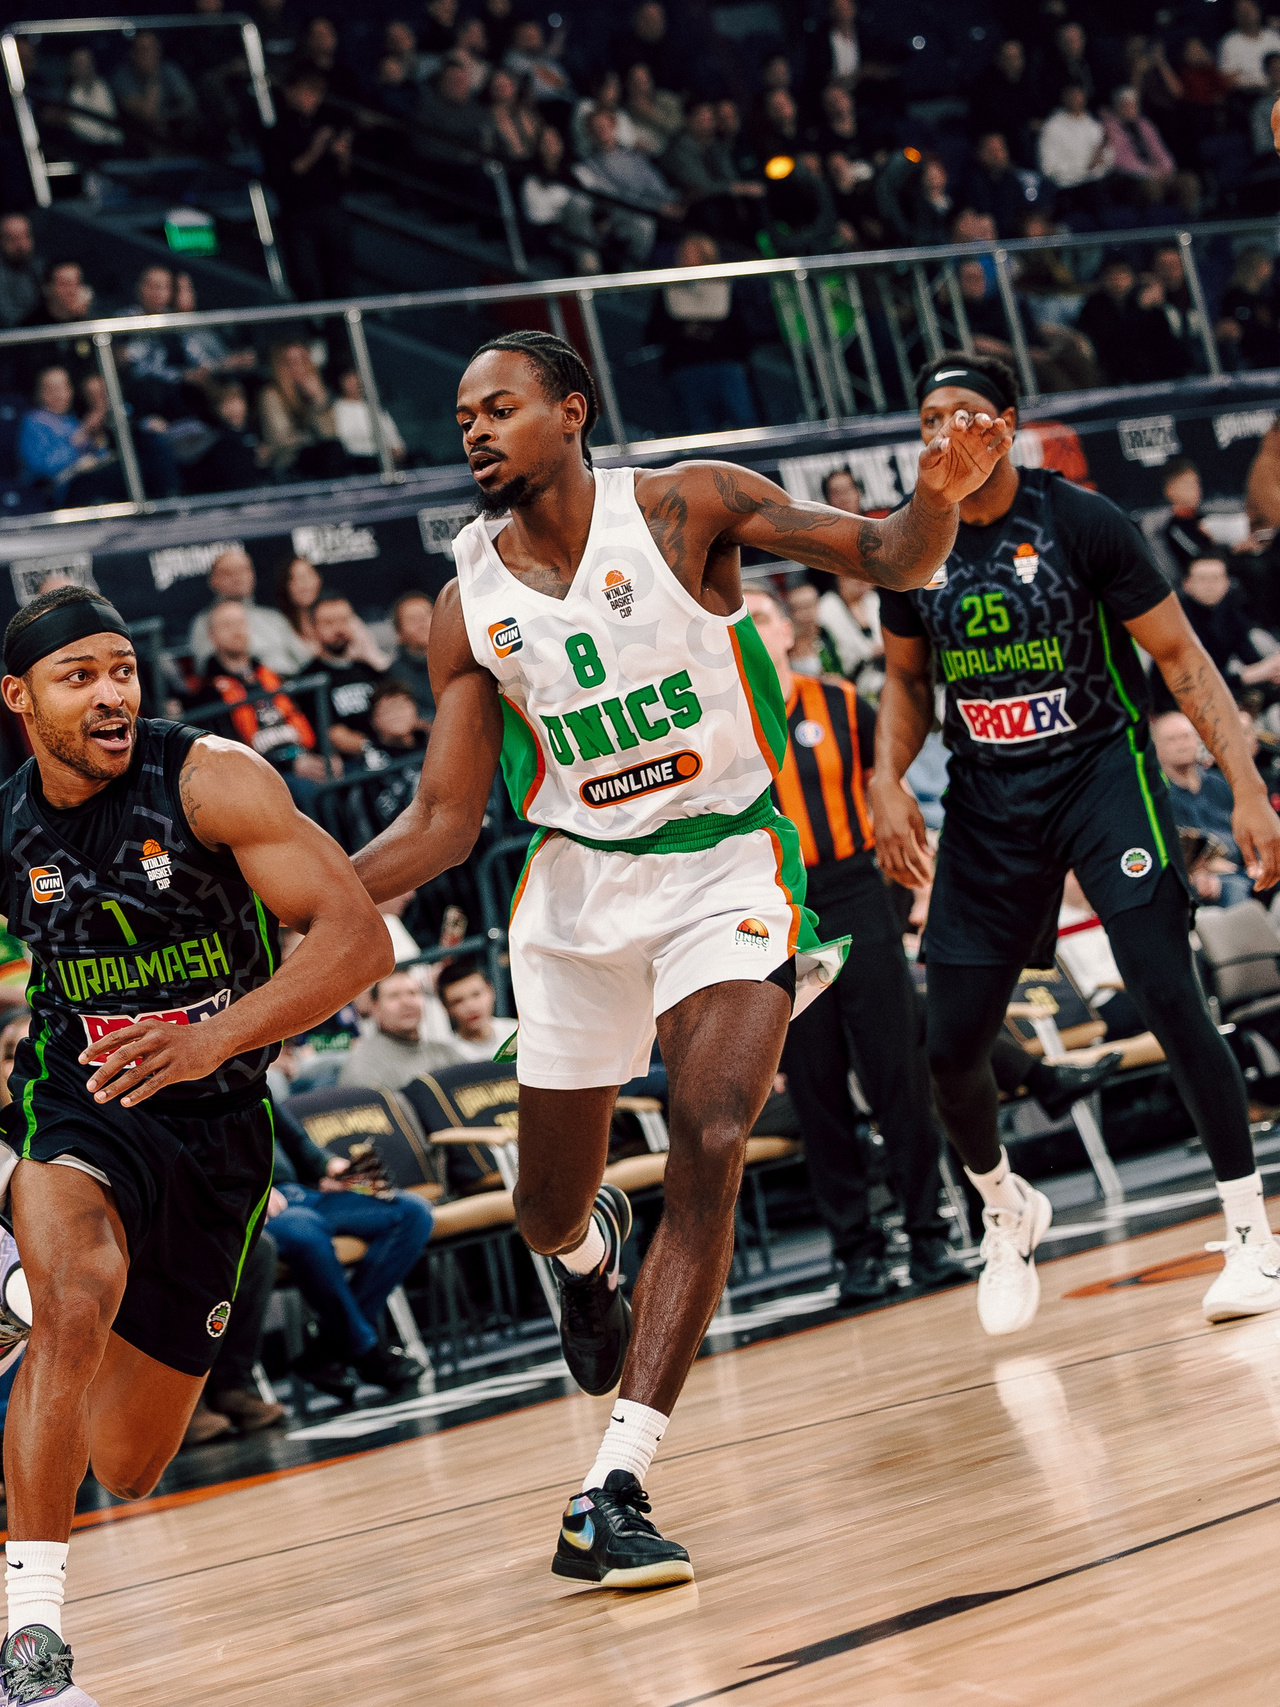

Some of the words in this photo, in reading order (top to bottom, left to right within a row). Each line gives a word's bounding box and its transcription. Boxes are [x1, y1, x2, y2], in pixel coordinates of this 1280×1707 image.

[604, 582, 634, 601] WINLINE
[610, 593, 635, 611] BASKET
[620, 607, 633, 619] CUP
[961, 592, 1012, 638] 25
[497, 626, 519, 646] WIN
[565, 632, 606, 689] 8
[940, 636, 1065, 683] URALMASH
[539, 669, 703, 766] UNICS
[962, 694, 1070, 739] BROZEX
[588, 761, 674, 802] WINLINE
[141, 854, 171, 871] WINLINE
[147, 865, 173, 882] BASKET
[39, 877, 61, 891] WIN
[156, 878, 171, 890] CUP
[101, 900, 138, 946] 1
[735, 931, 769, 948] UNICS
[57, 931, 231, 1002] URALMASH
